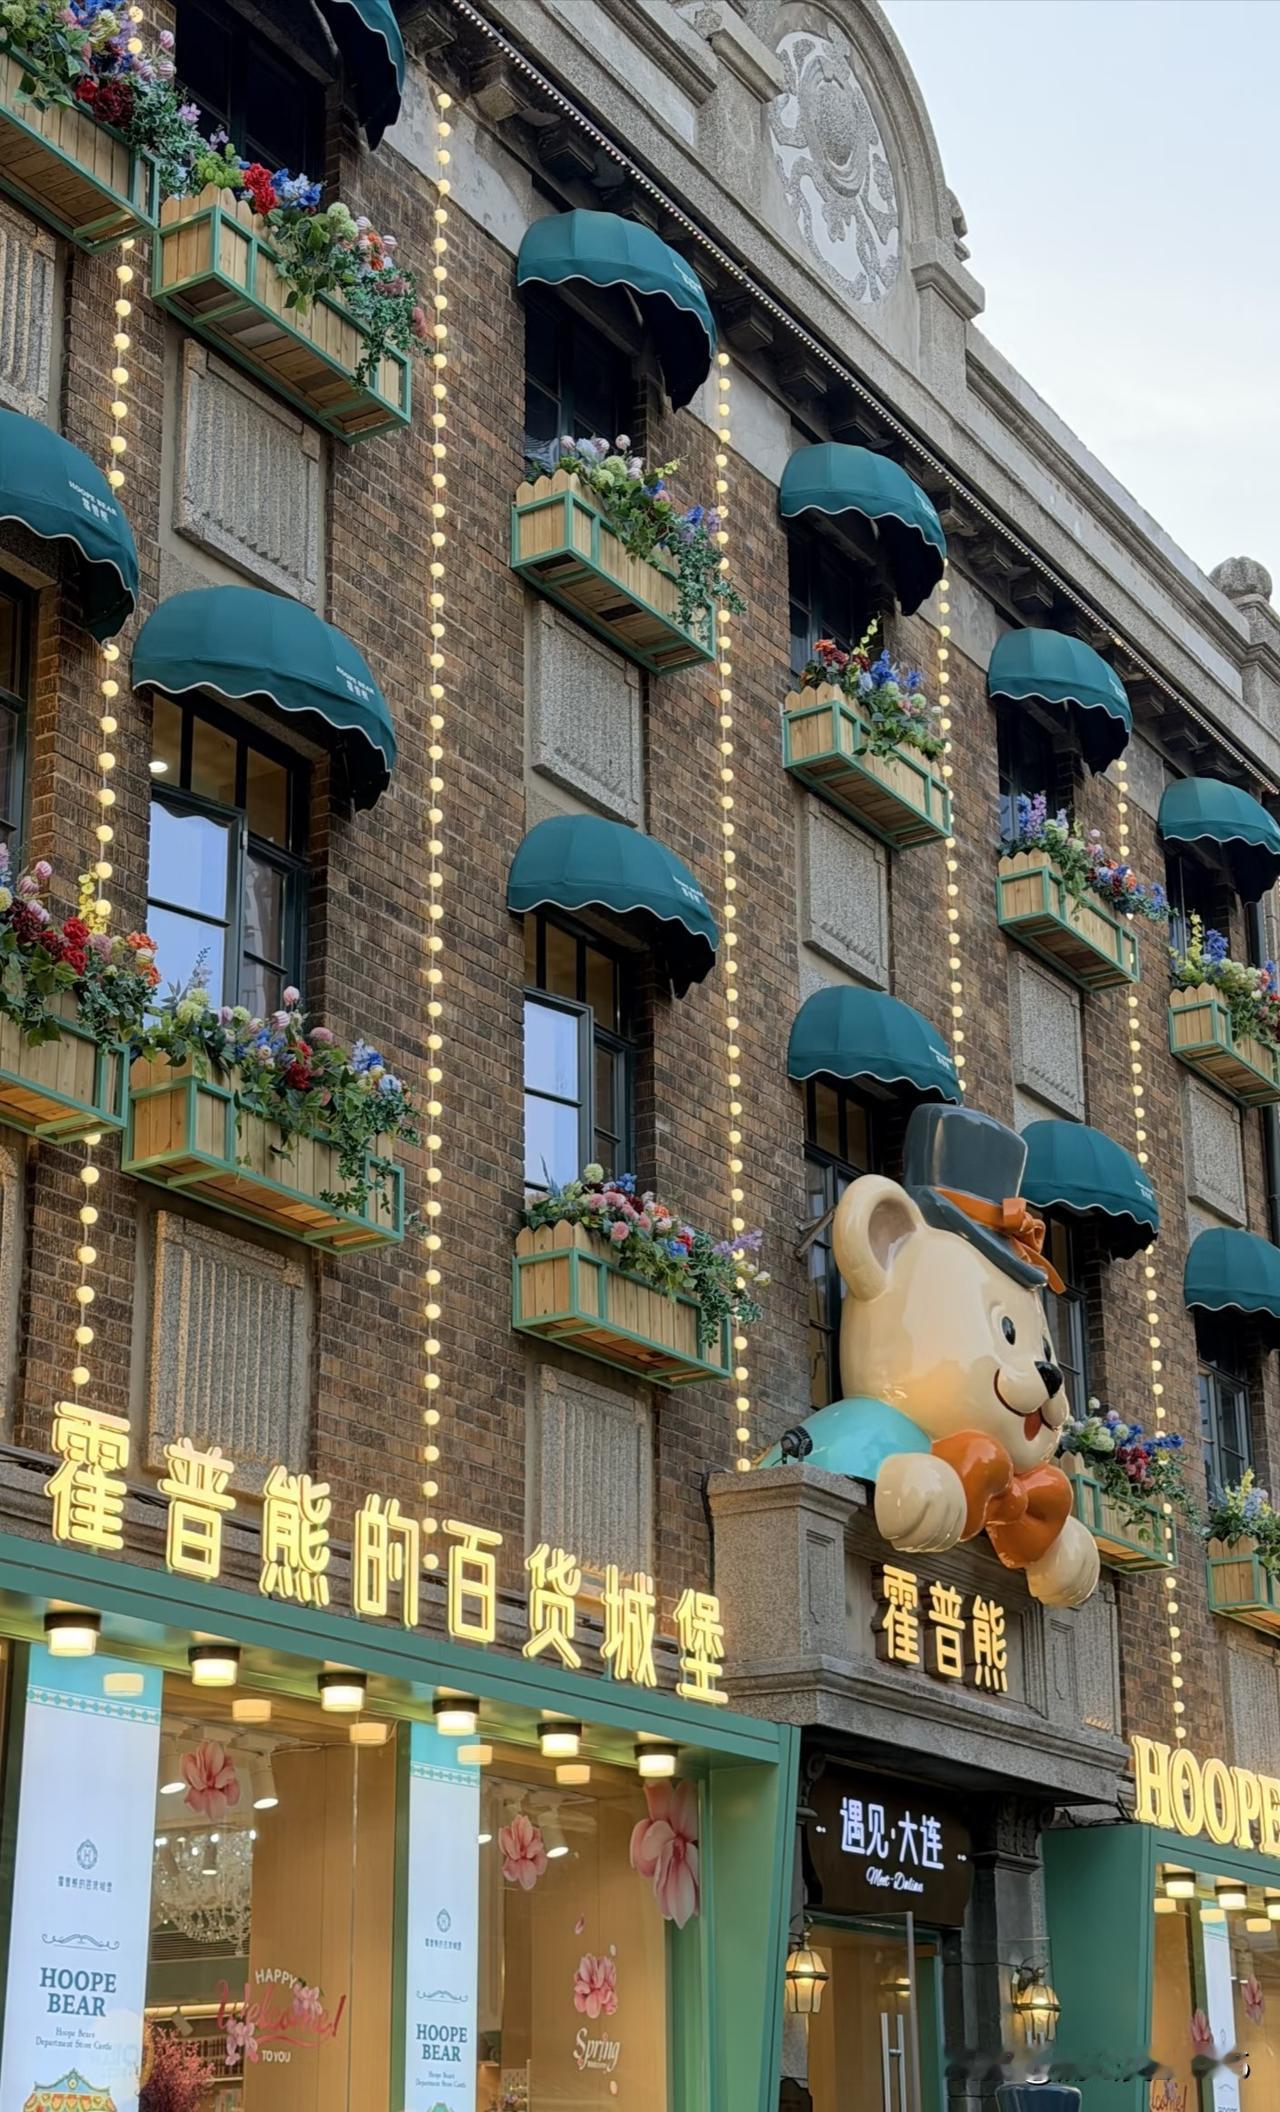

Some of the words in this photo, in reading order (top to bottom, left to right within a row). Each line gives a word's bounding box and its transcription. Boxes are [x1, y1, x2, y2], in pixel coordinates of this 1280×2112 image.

[44, 1401, 729, 1705] 霍普熊的百货城堡
[882, 1563, 1008, 1693] 霍普熊
[1131, 1734, 1280, 1858] HOOPE
[39, 1966, 117, 1994] HOOPE
[255, 1968, 298, 1989] HAPPY
[46, 1992, 106, 2017] BEAR
[35, 2036, 73, 2049] Department
[416, 2023, 468, 2043] HOOPE
[262, 2050, 273, 2062] TO
[273, 2050, 291, 2063] YOU
[422, 2043, 461, 2062] BEAR
[573, 2027, 620, 2072] Spring
